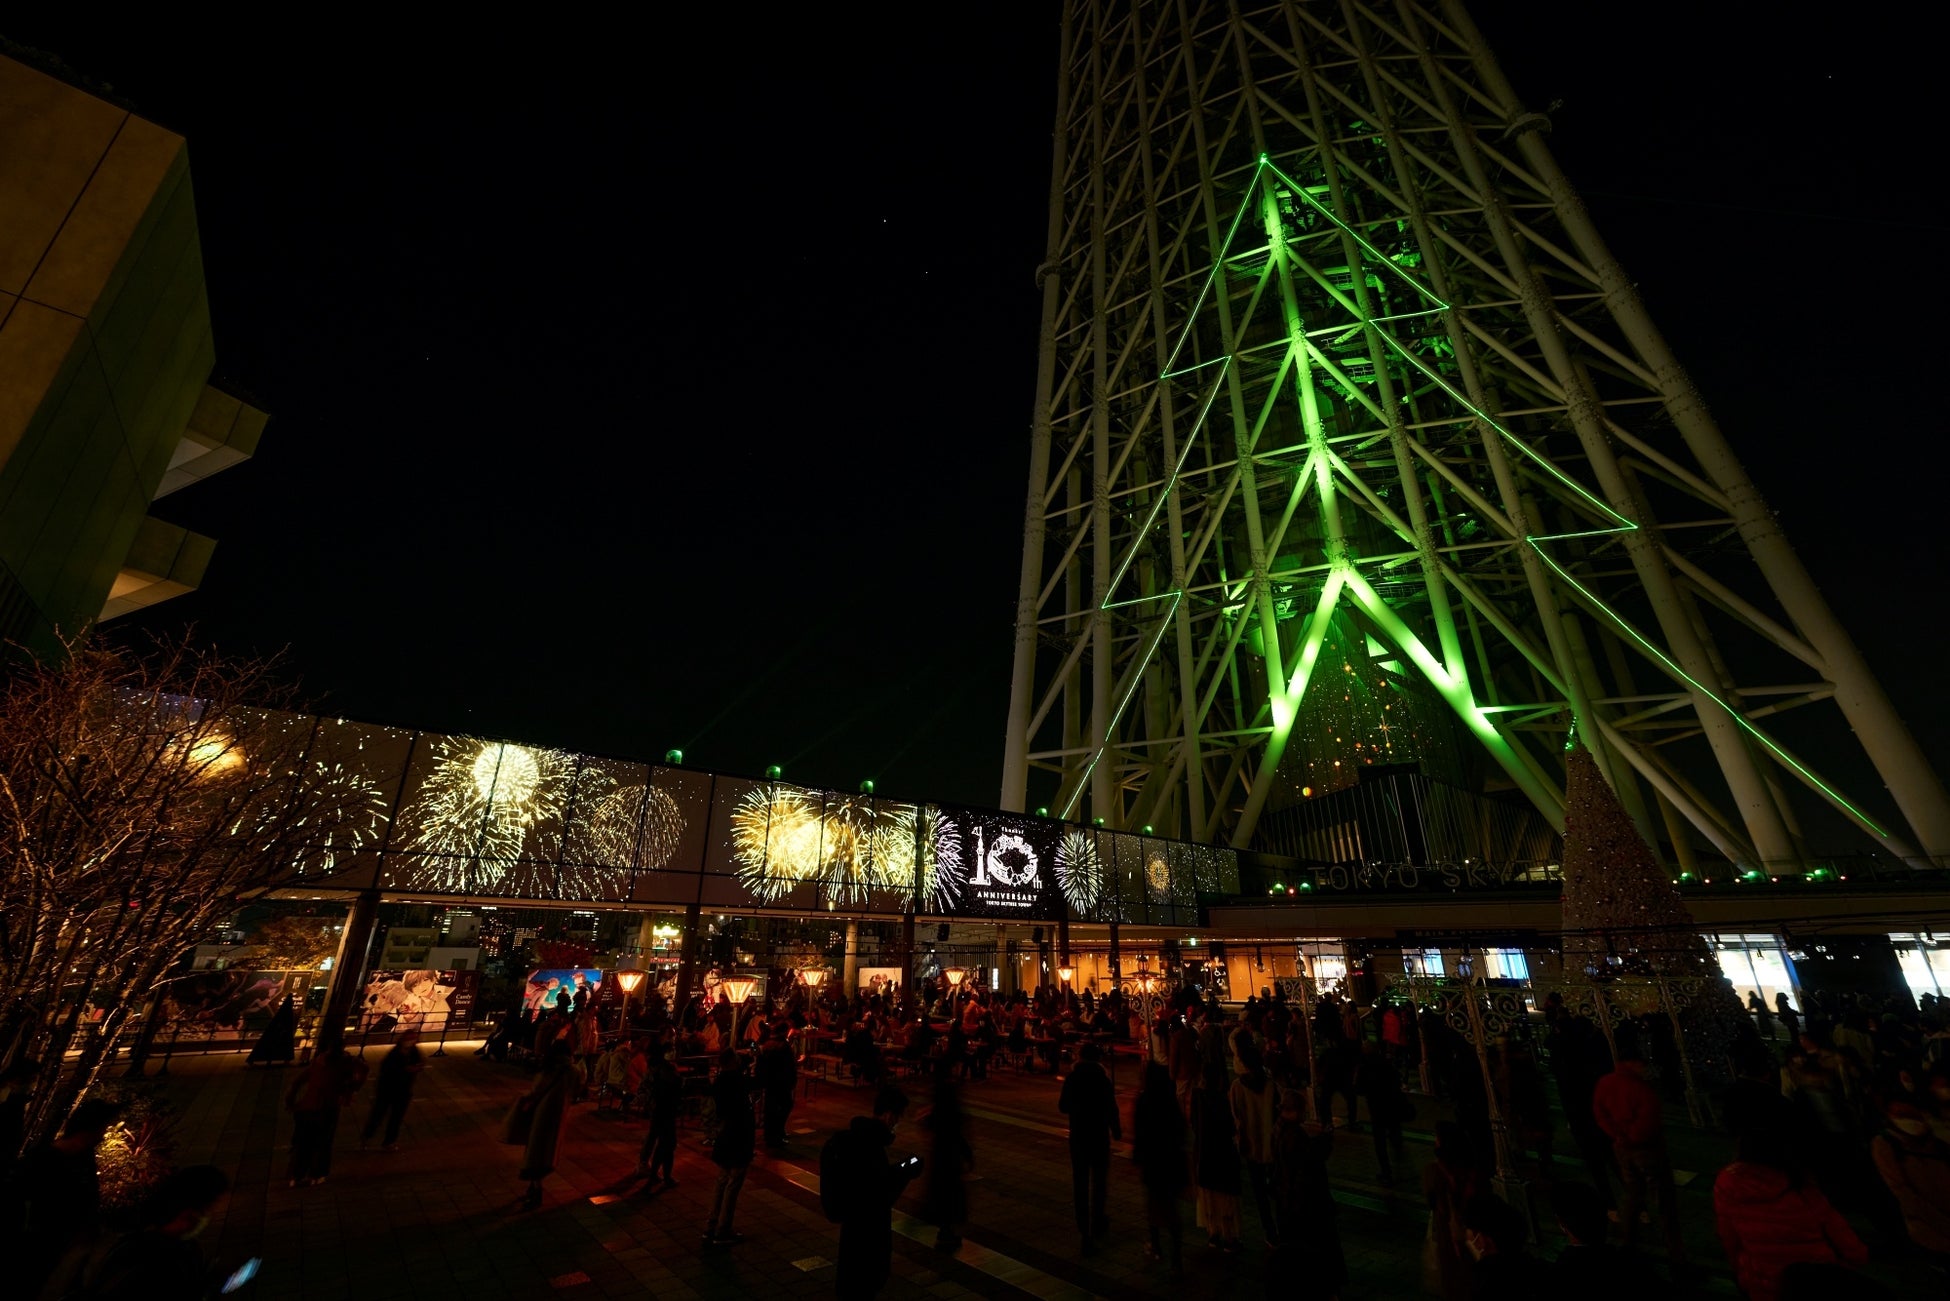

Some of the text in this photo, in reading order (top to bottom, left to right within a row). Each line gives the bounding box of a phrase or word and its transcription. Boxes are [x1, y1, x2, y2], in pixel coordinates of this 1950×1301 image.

[1307, 859, 1564, 891] TOKYO SKYTR
[977, 890, 1038, 902] ANNIVERSARY
